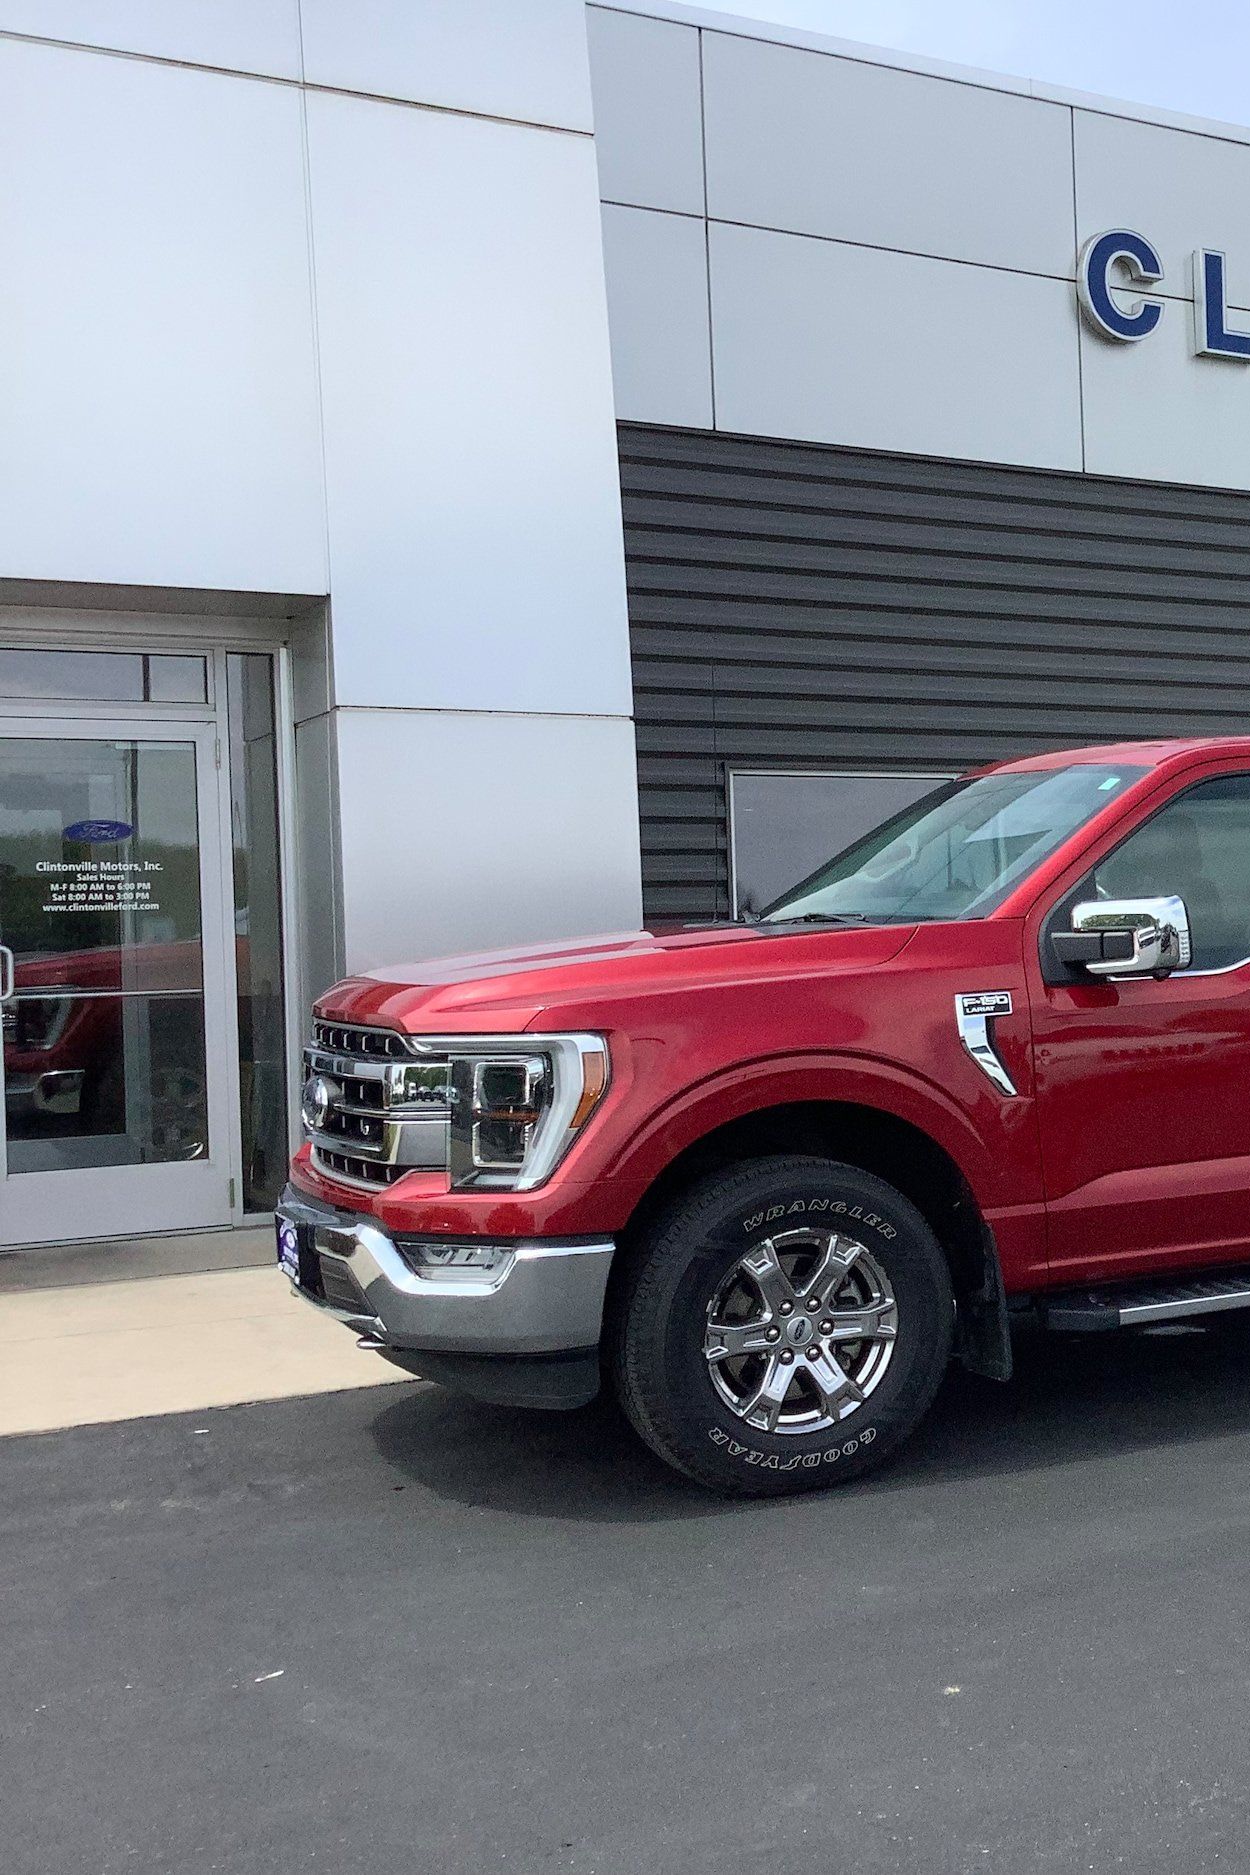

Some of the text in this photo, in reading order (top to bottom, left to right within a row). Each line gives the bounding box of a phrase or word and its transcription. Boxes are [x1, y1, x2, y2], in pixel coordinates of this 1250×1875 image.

[36, 861, 164, 872] Clintonville Motors, Inc.
[76, 873, 125, 881] Sales Hours
[50, 882, 151, 891] M-F 8:00 AM to 6:00 PM
[52, 893, 66, 901] Sat
[68, 893, 86, 901] 8:00
[88, 893, 103, 901] AM
[116, 892, 134, 900] 3:00
[136, 892, 150, 900] PM
[42, 902, 160, 912] www.clintonvilleford.com
[963, 995, 1008, 1007] F-150
[743, 1199, 897, 1239] WRANGLER
[709, 1428, 876, 1470] GOODYEAR
